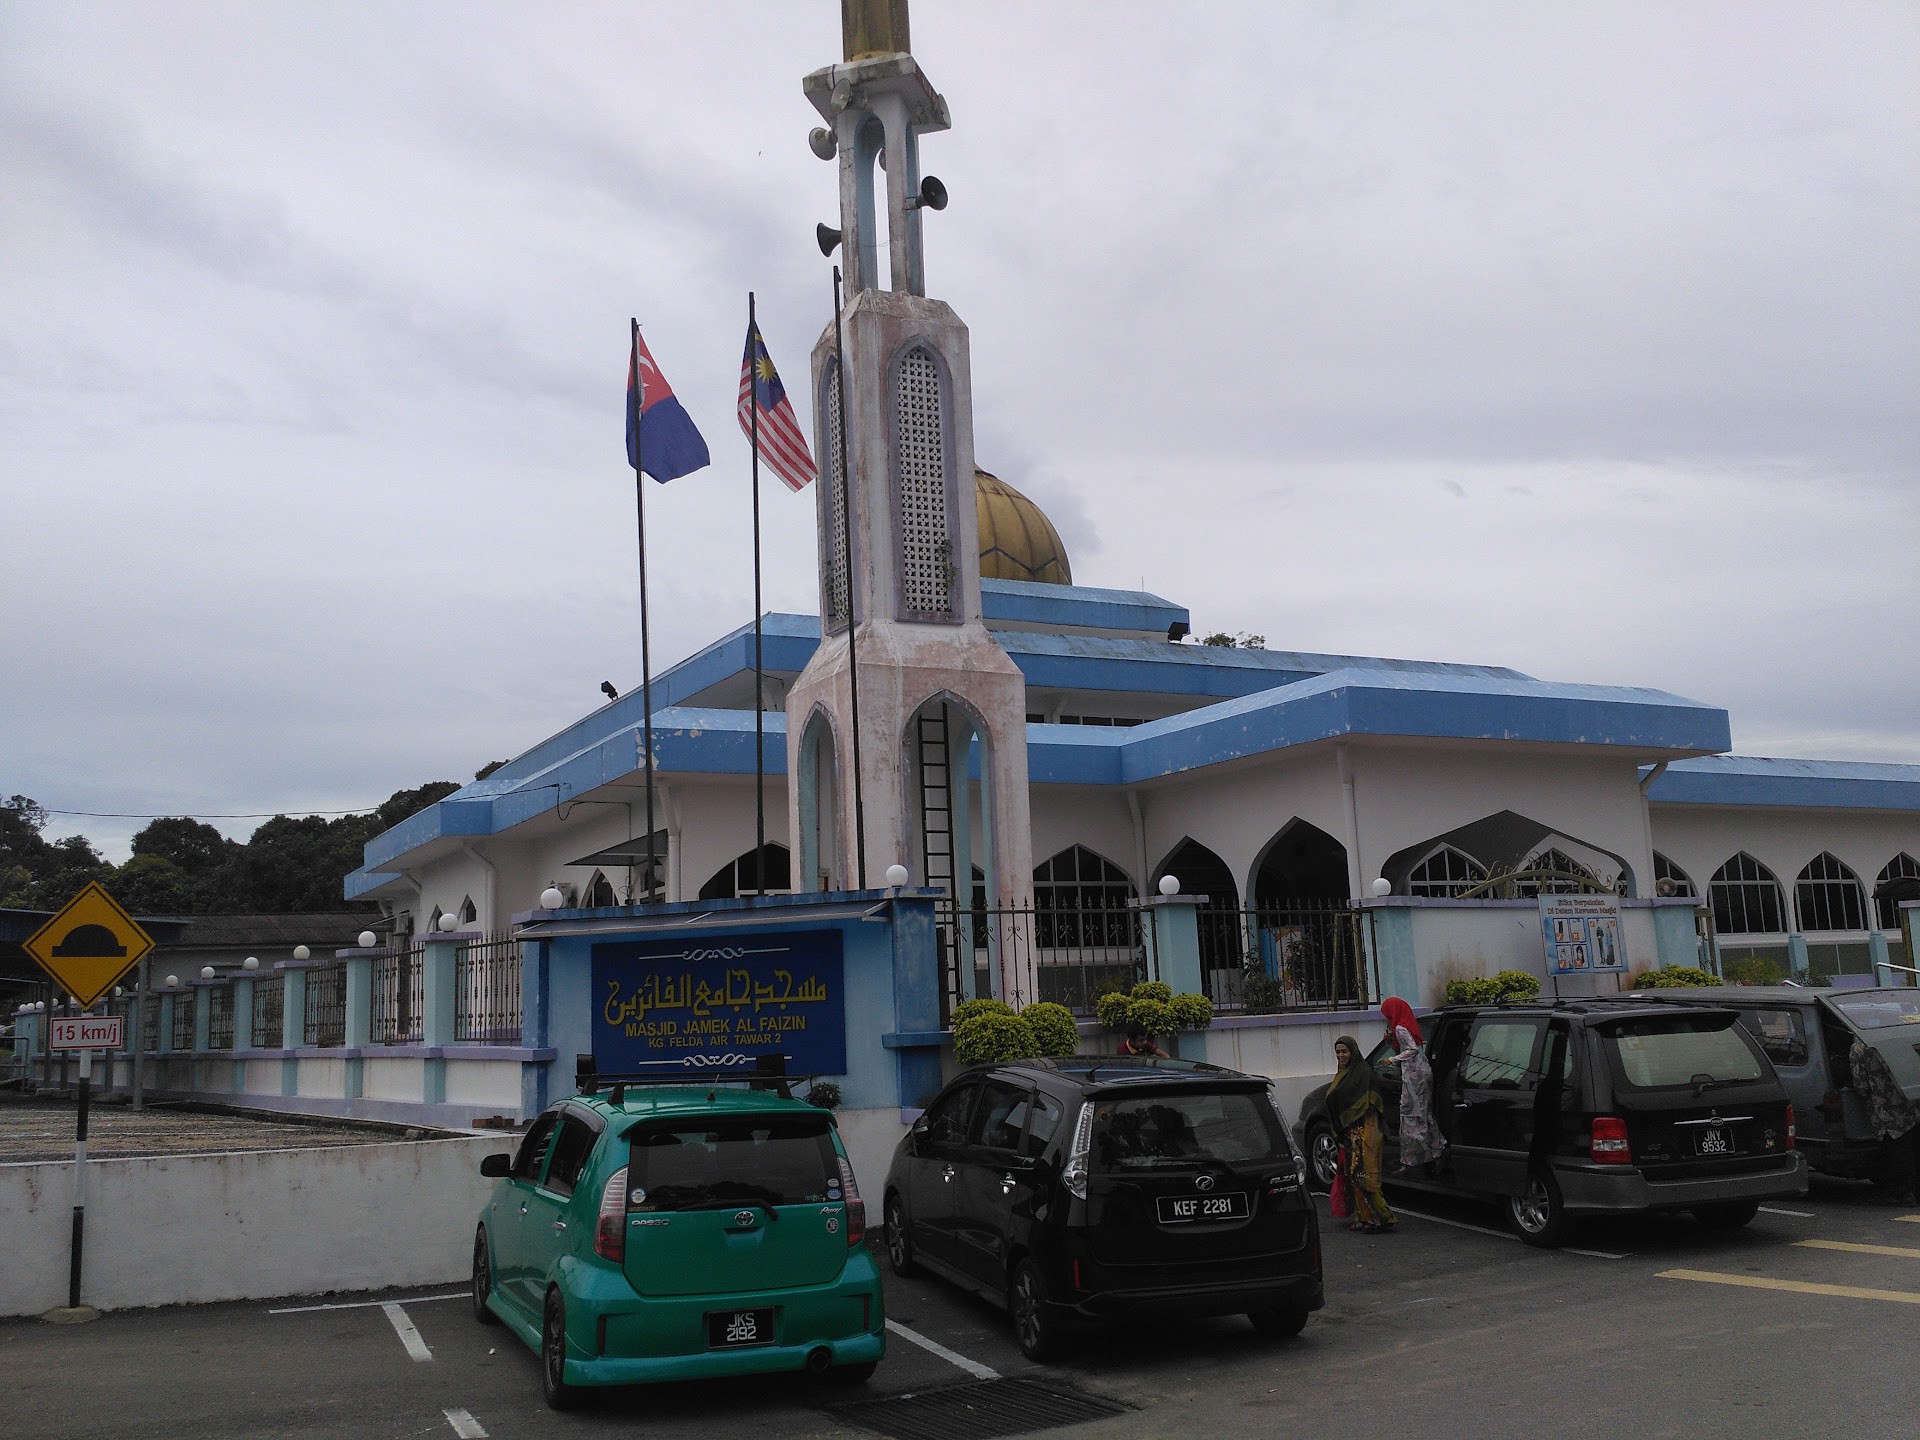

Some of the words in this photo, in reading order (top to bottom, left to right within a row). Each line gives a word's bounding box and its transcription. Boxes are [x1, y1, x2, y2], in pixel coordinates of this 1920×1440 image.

[56, 1025, 76, 1041] 15
[81, 1023, 117, 1043] km/j
[625, 1021, 677, 1037] MASJID
[683, 1018, 731, 1035] JAMEK
[736, 1017, 756, 1032] AL
[759, 1015, 806, 1031] FAIZIN
[669, 1035, 704, 1047] FELDA
[709, 1035, 728, 1046] AIR
[733, 1034, 772, 1045] TAWAR
[775, 1034, 782, 1043] 2
[1704, 1129, 1721, 1141] JNY
[1702, 1140, 1727, 1152] 9532
[1174, 1200, 1198, 1216] KEF
[1203, 1198, 1232, 1213] 2281
[729, 1313, 755, 1327] JKS
[726, 1326, 757, 1341] 2192
